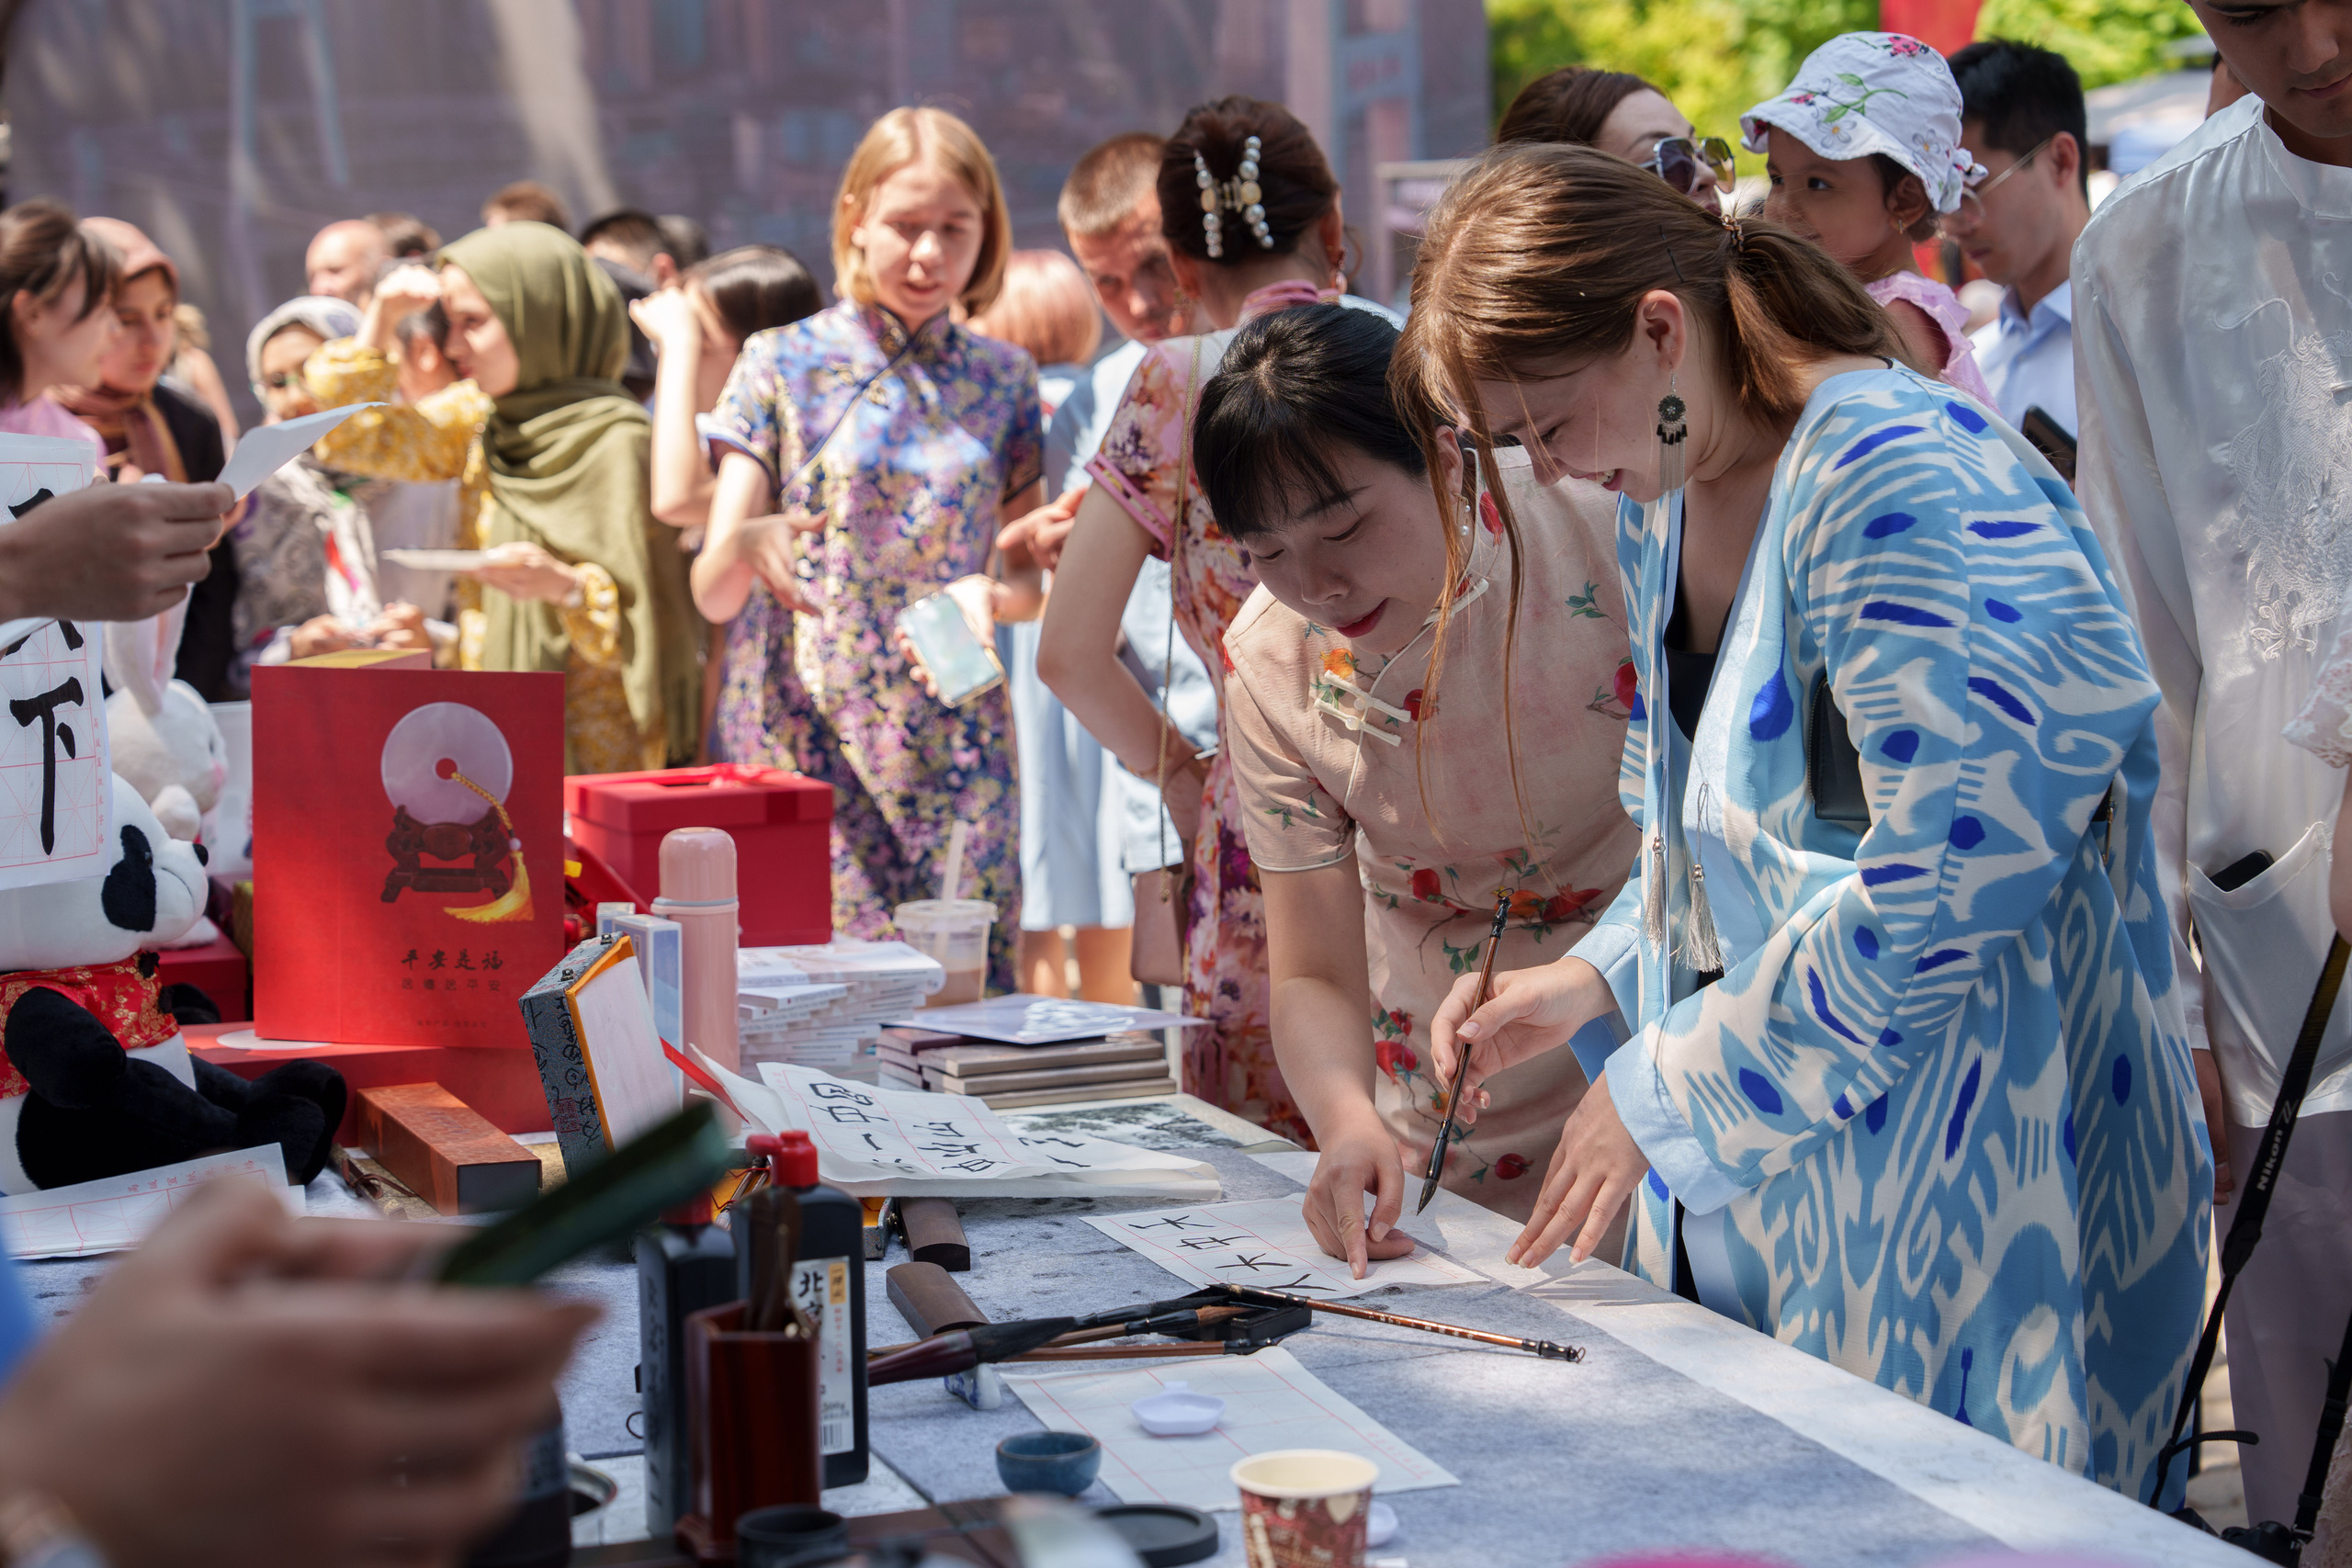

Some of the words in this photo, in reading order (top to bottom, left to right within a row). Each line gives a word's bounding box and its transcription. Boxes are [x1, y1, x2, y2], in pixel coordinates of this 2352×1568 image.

[401, 948, 503, 971] 平安是福
[2256, 1129, 2283, 1191] Nikon
